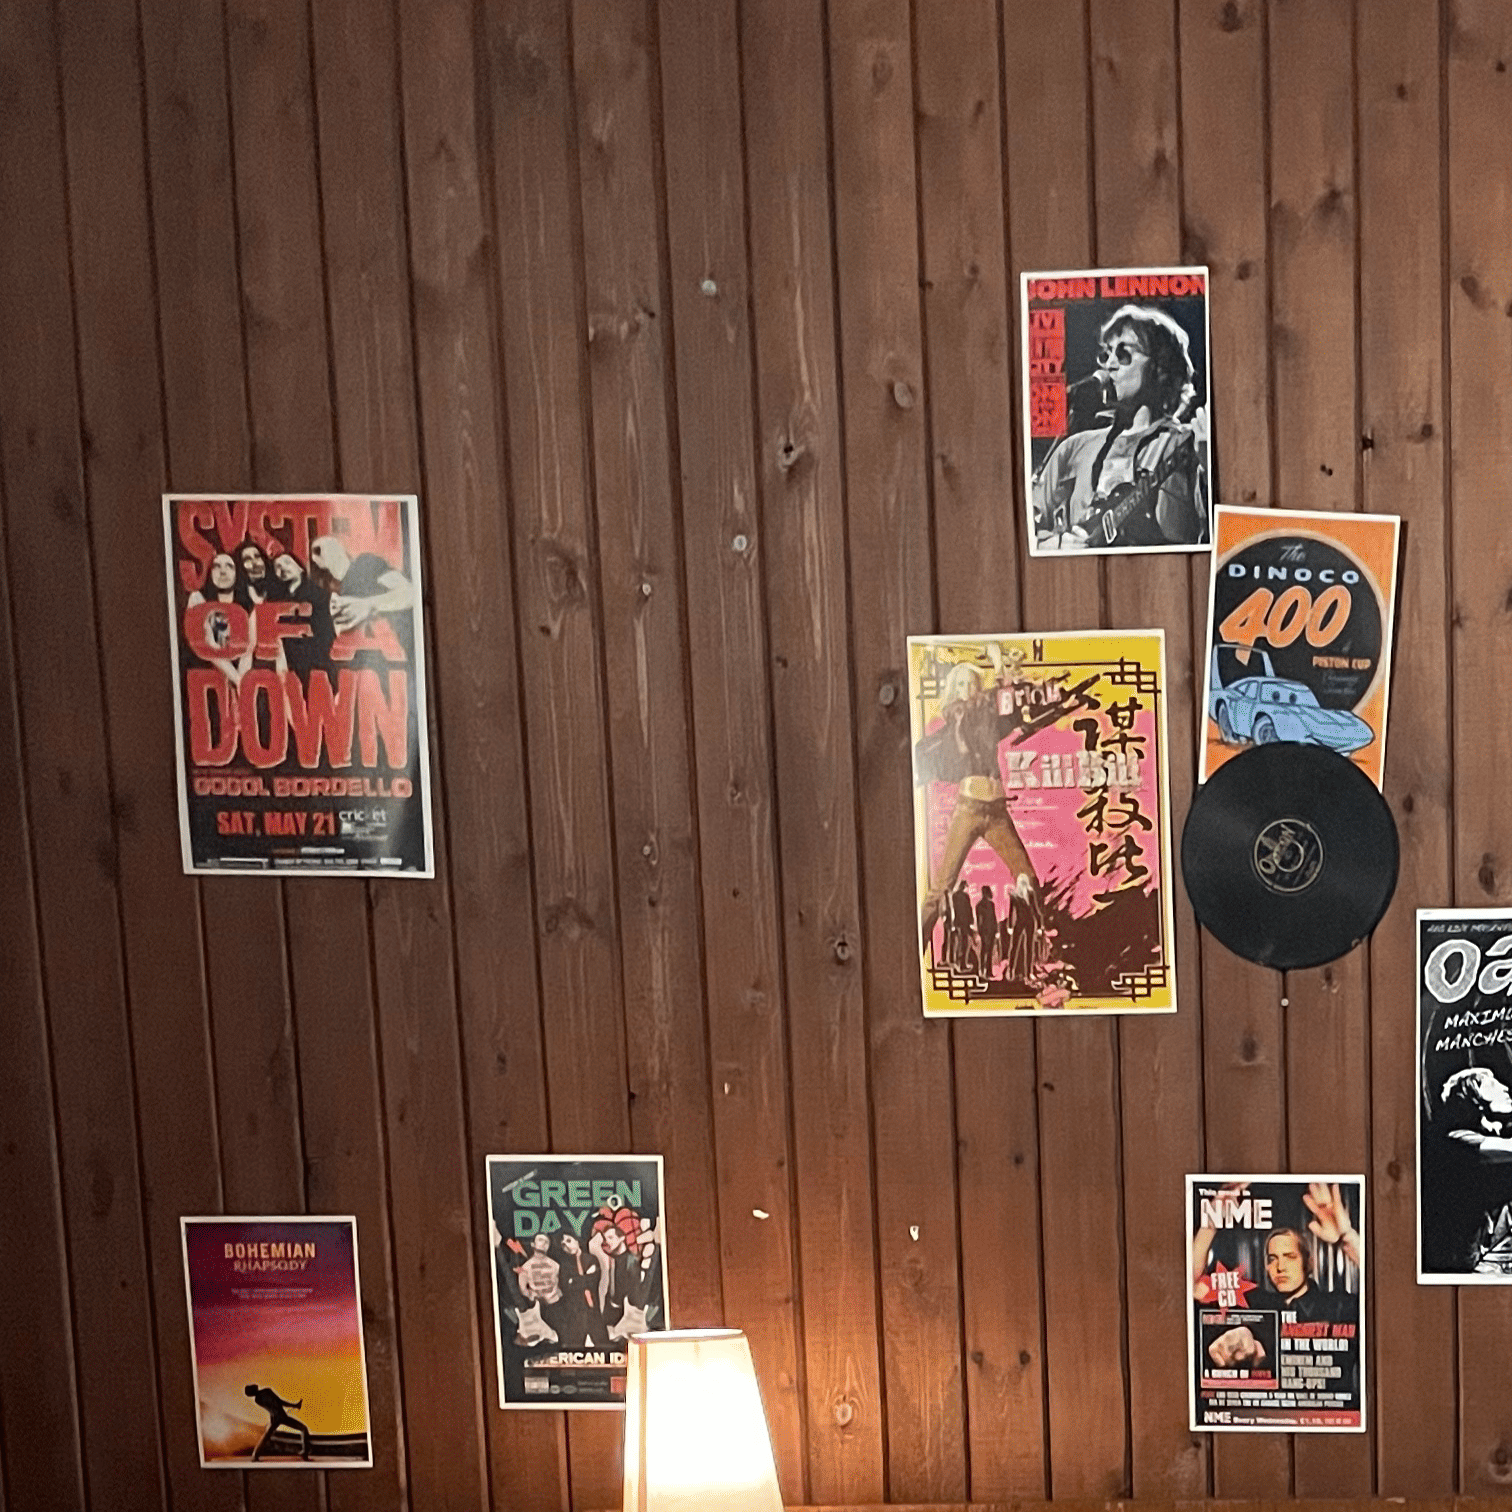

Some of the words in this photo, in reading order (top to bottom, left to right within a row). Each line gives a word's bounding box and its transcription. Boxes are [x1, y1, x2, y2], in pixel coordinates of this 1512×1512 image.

[1028, 279, 1096, 300] JOHN
[1101, 275, 1205, 297] LENNON
[1228, 563, 1360, 584] DINOCO
[184, 601, 313, 660] OF
[330, 617, 406, 661] A
[1219, 584, 1352, 666] 400
[187, 669, 407, 769] DOWN
[1005, 751, 1076, 789] Kill
[273, 777, 412, 798] BORDELLO
[264, 811, 307, 836] MAY
[312, 811, 336, 836] 21
[512, 1180, 641, 1207] GREEN
[514, 1209, 590, 1237] DAY
[1201, 1199, 1272, 1229] NME
[224, 1242, 316, 1259] BOHEMIAN
[233, 1259, 308, 1273] RHAPSODY
[1210, 1271, 1240, 1290] FREE
[1218, 1288, 1237, 1307] CD
[524, 1352, 606, 1368] ERICAN
[1204, 1411, 1231, 1423] NME
